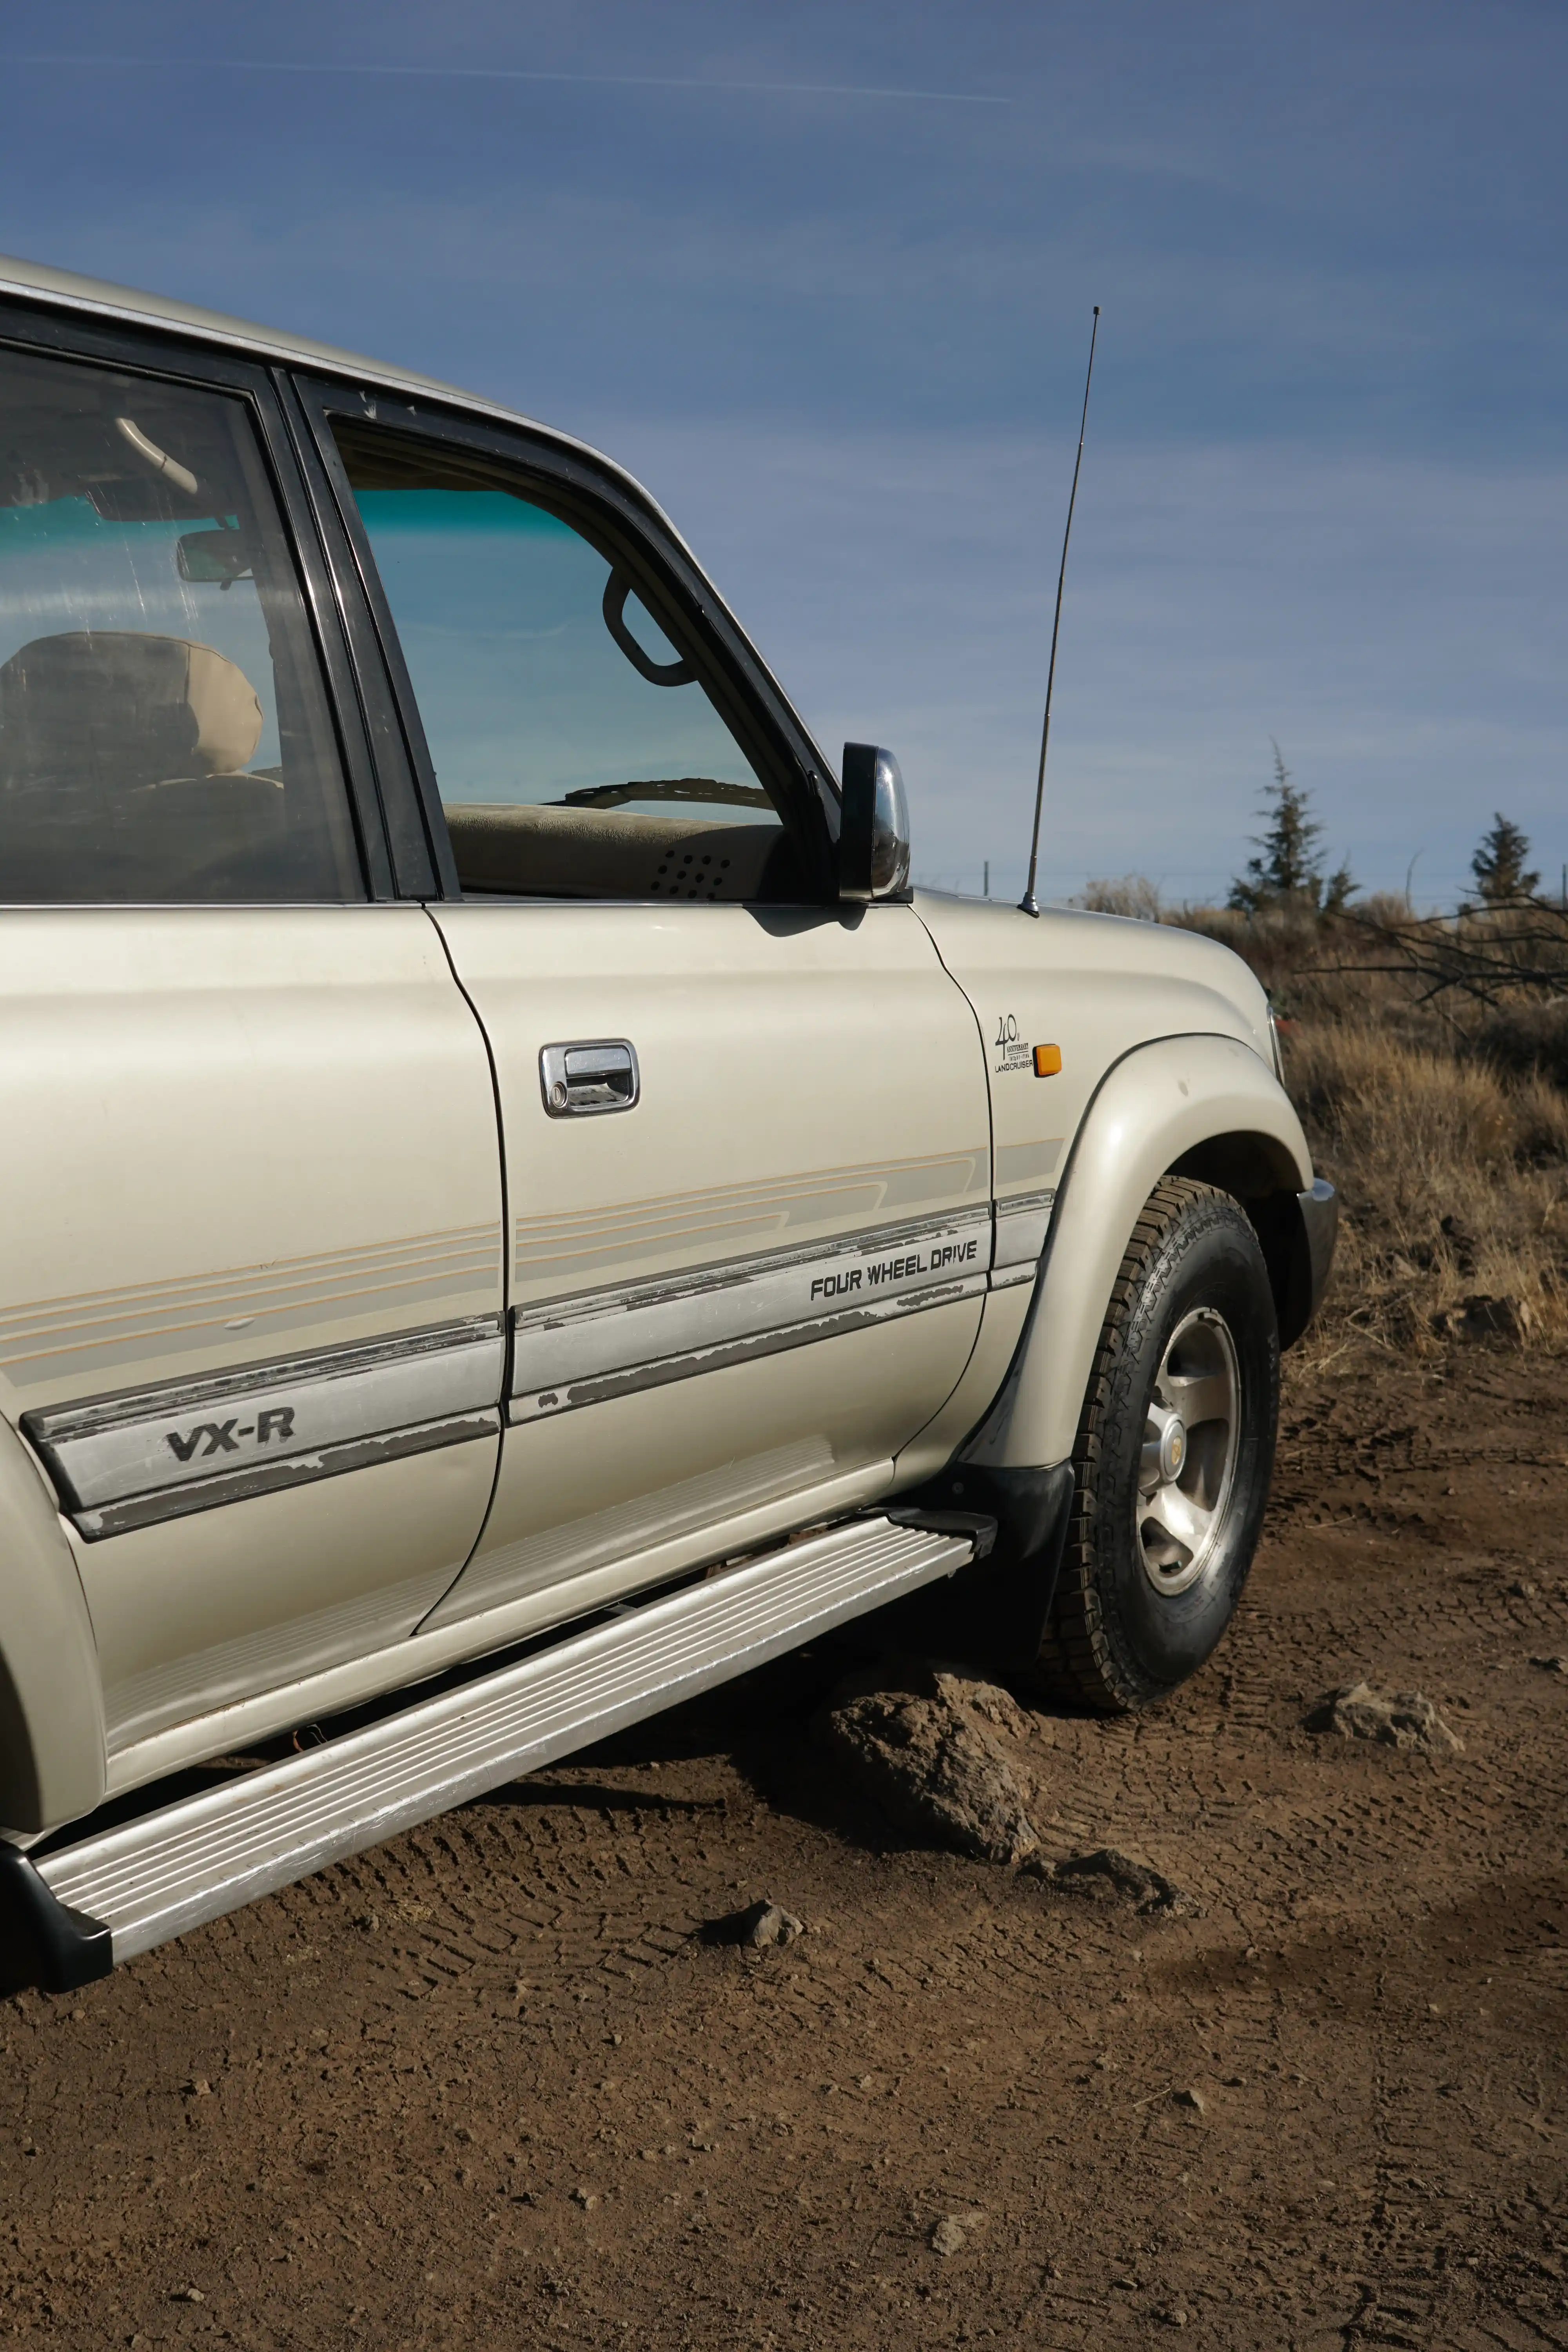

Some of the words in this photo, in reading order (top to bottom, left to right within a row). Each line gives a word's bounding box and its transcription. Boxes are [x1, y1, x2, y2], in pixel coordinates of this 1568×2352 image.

[1007, 1043, 1029, 1053] ANNIVERSARY
[995, 1060, 1033, 1073] LANDCRUISER
[811, 1269, 862, 1301] FOUR
[867, 1254, 927, 1286] WHEEL
[930, 1240, 977, 1271] DRIVE
[166, 1406, 295, 1462] VX-R
